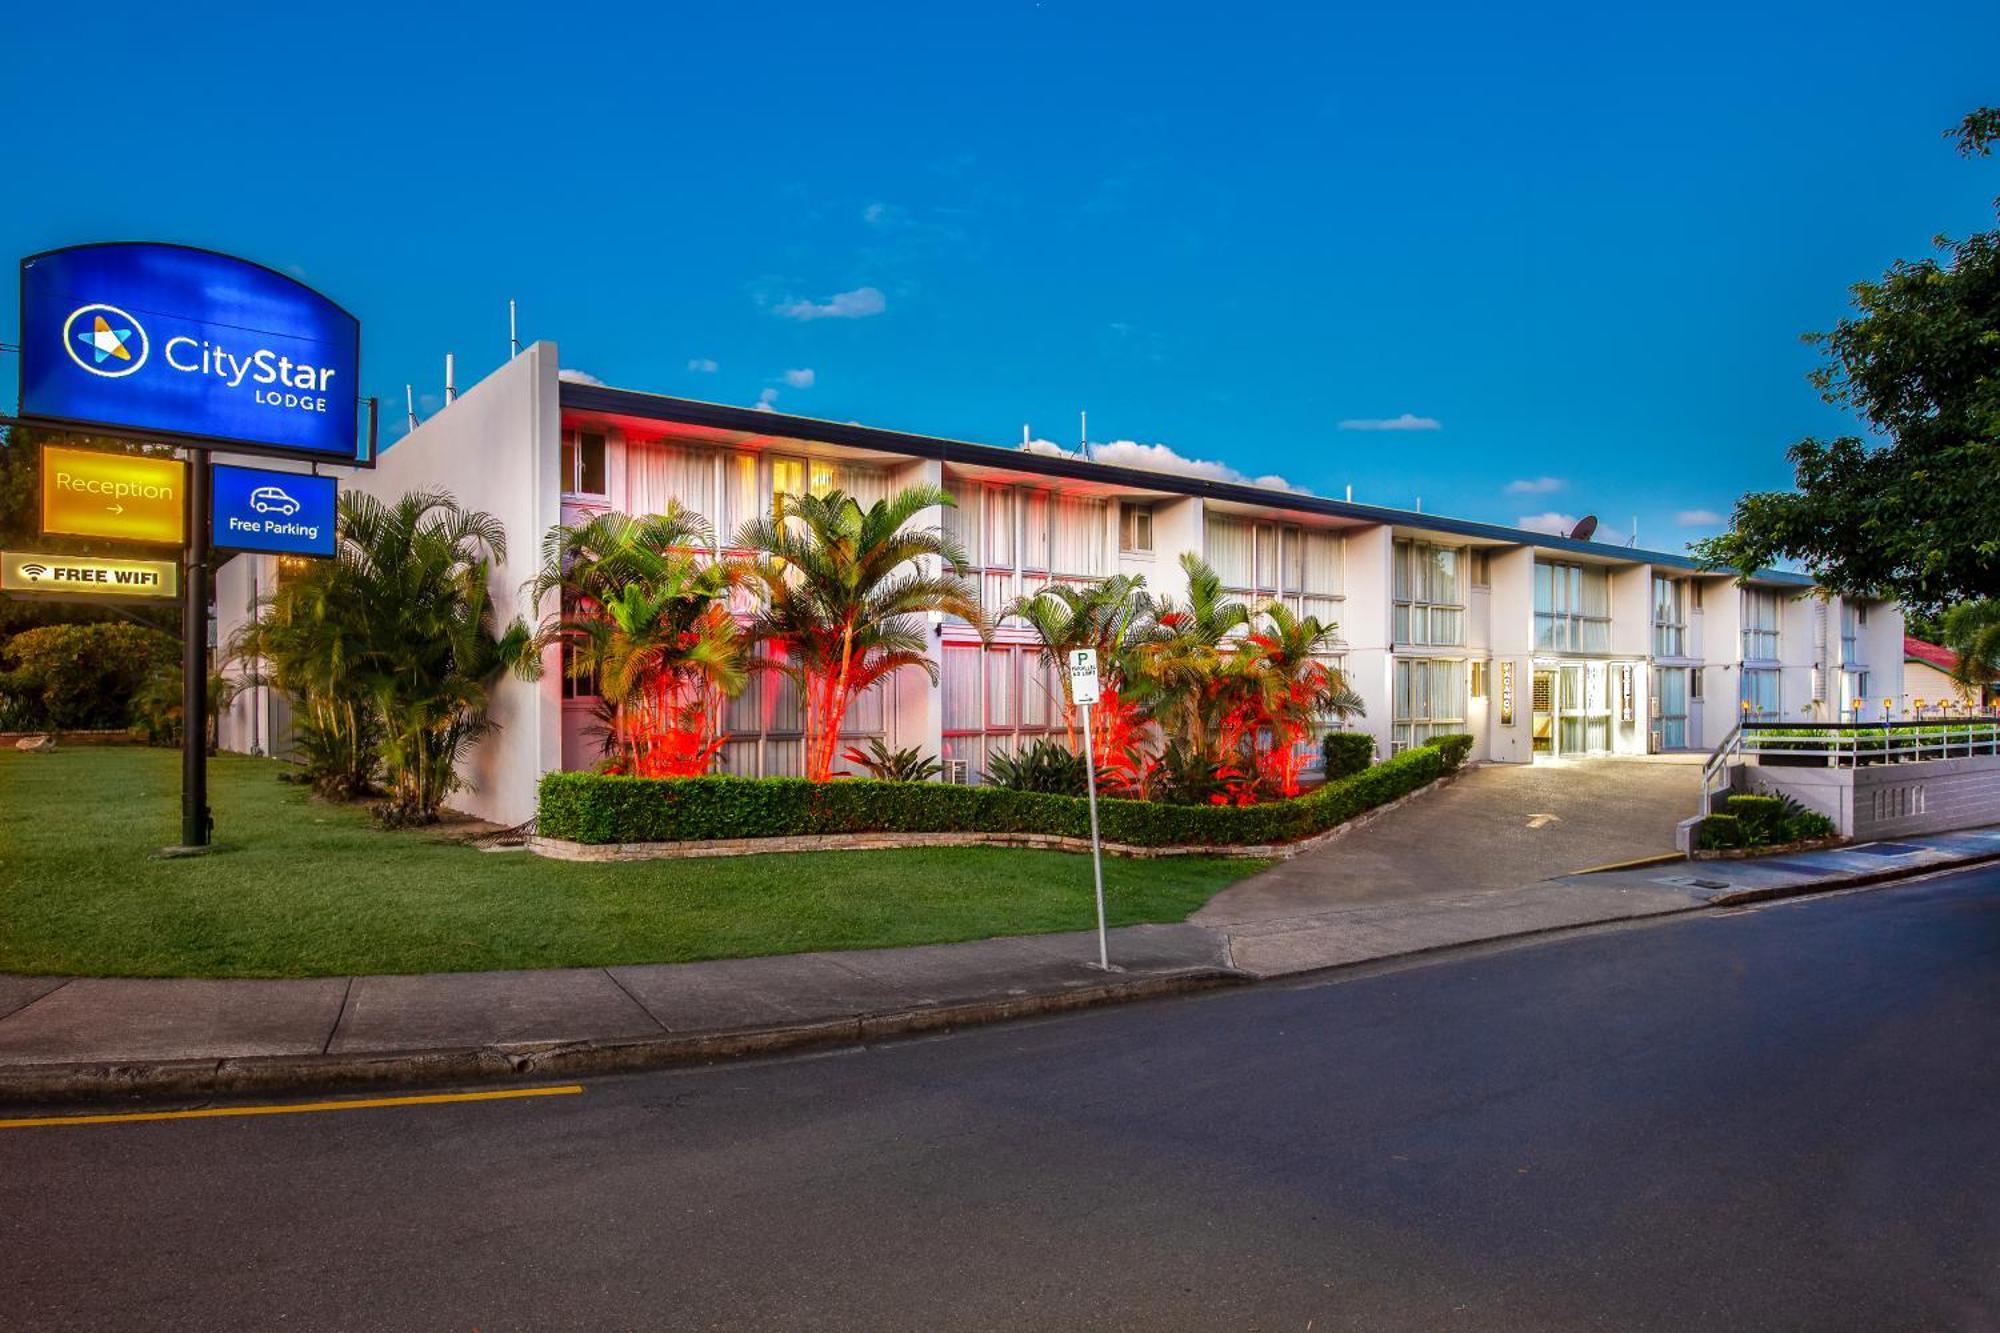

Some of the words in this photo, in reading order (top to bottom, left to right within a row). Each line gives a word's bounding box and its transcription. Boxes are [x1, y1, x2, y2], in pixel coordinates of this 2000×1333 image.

[165, 336, 335, 391] CityStar
[255, 390, 326, 412] LODGE
[57, 472, 173, 500] Reception
[229, 517, 260, 532] Free
[54, 567, 107, 583] FREE
[114, 570, 158, 585] WIFI
[1078, 652, 1088, 665] P
